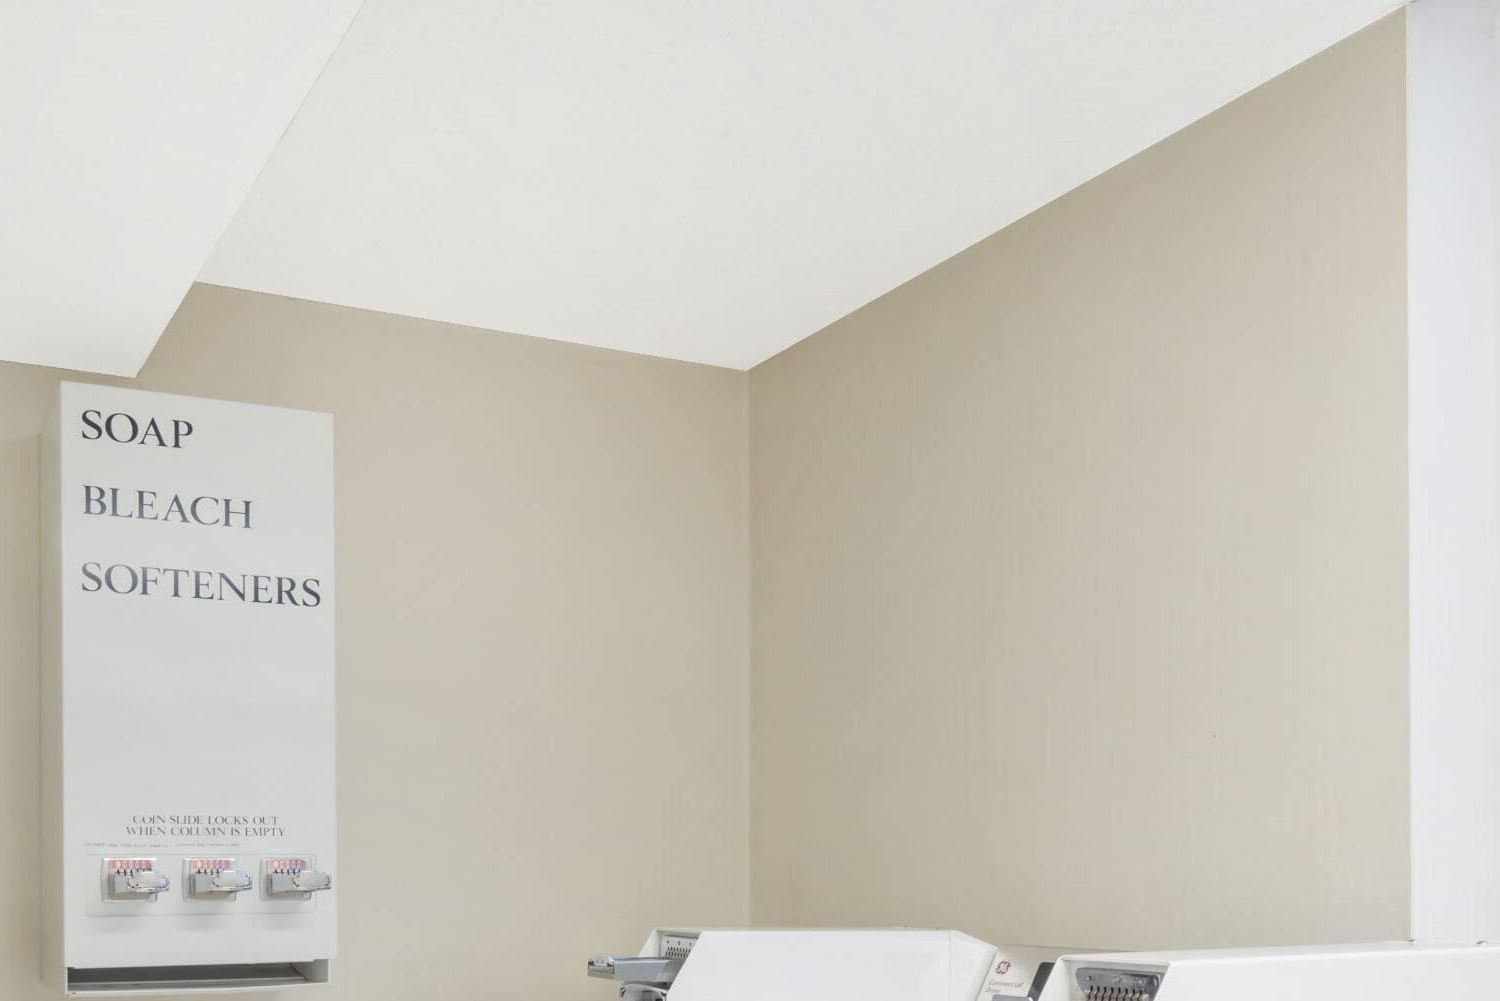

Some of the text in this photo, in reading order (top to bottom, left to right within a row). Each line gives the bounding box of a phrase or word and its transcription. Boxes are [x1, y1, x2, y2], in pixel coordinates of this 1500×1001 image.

[81, 408, 193, 449] SOAP
[81, 484, 253, 529] BLEACH
[81, 561, 322, 608] SOFTENERS
[125, 826, 285, 837] WHEN COLUMN IS EMPTY
[132, 815, 279, 826] COIN SLIDE LOCKS OUT
